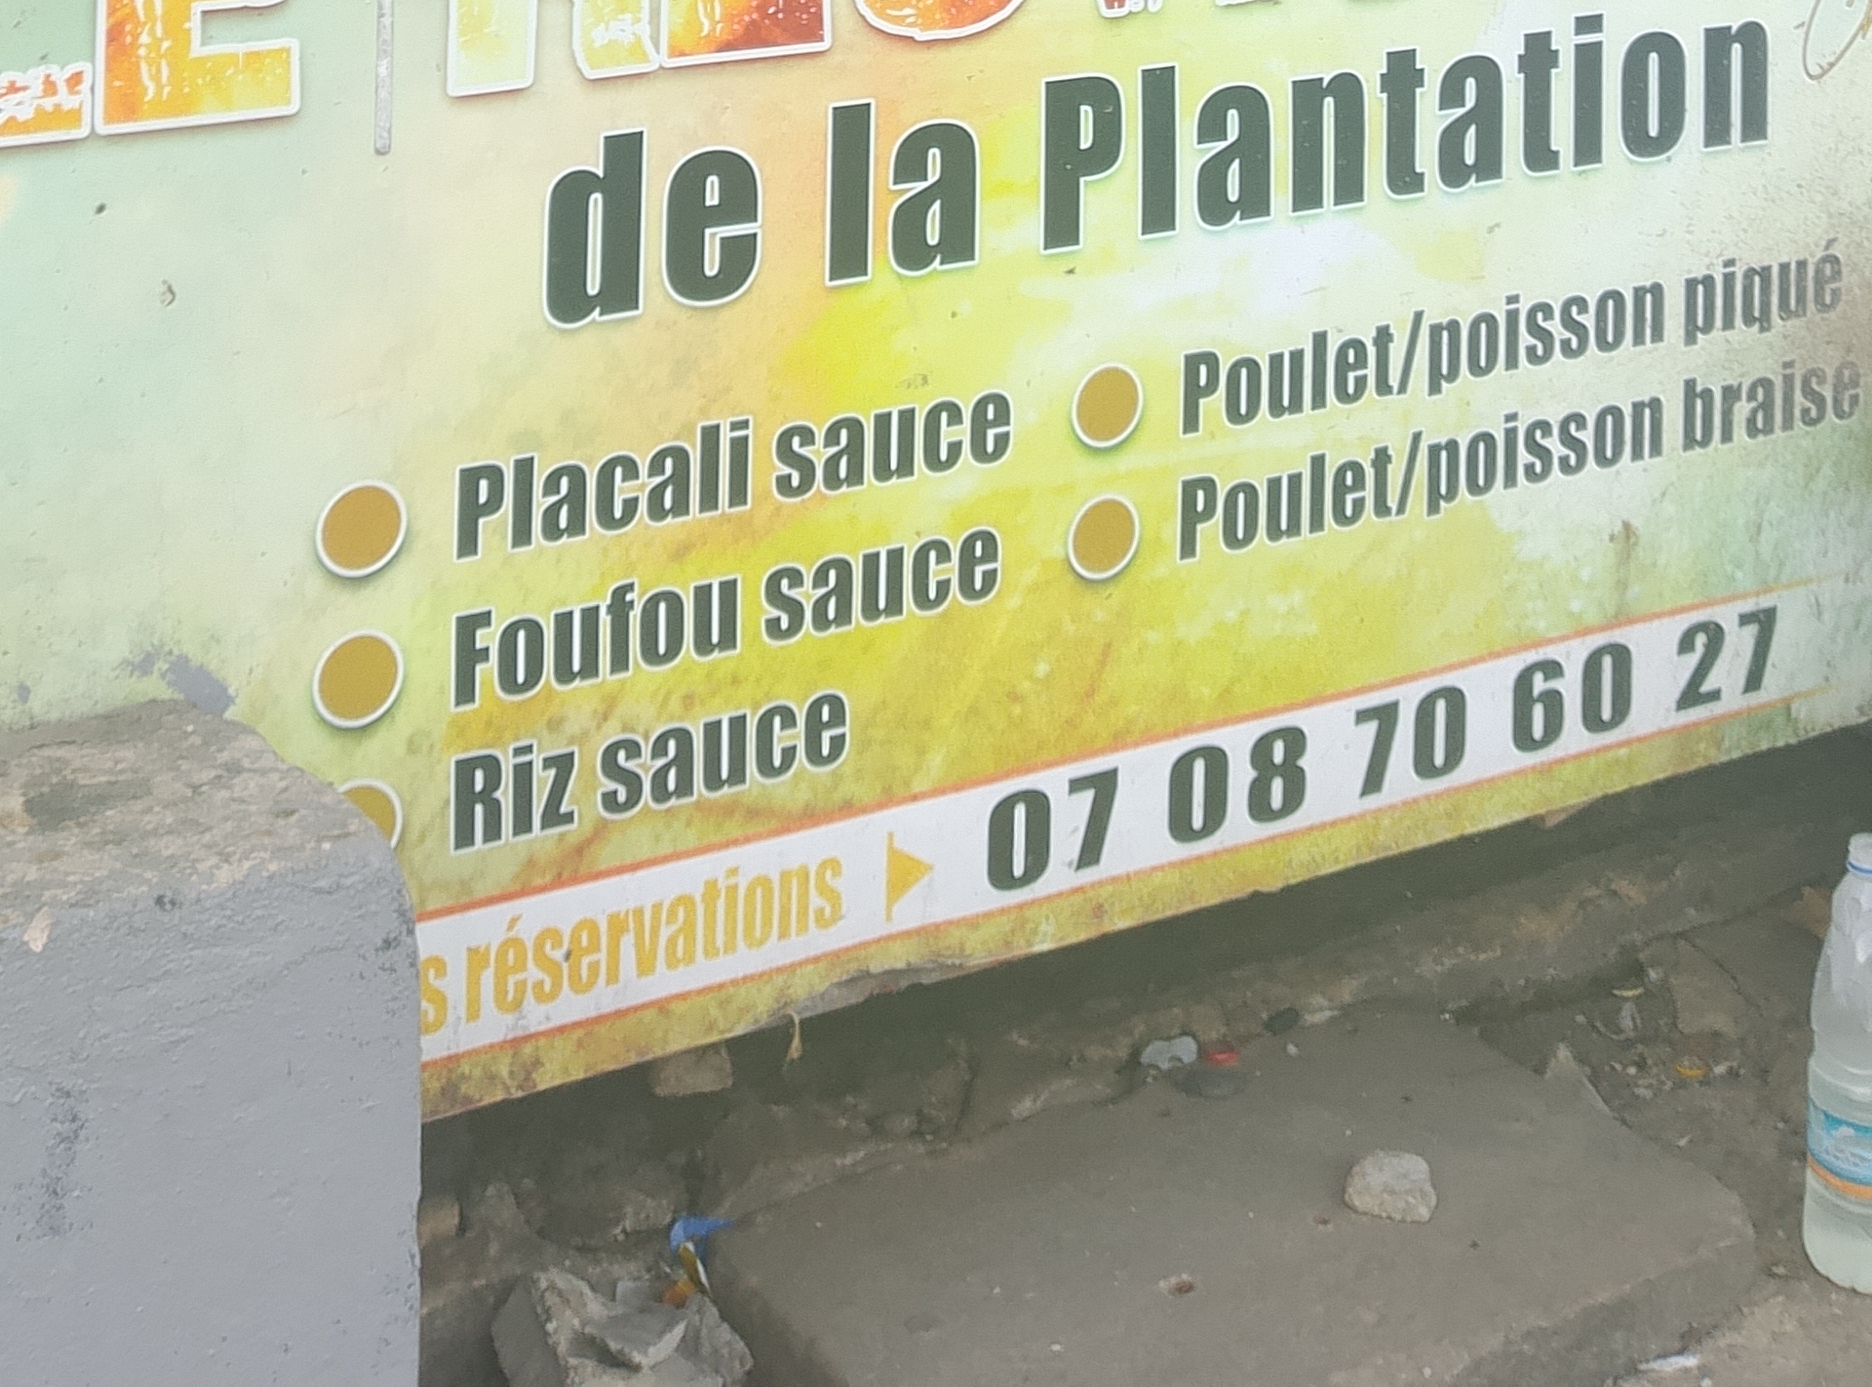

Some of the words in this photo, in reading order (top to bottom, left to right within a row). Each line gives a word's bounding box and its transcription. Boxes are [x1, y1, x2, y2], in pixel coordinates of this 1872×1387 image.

[543, 128, 762, 330] de
[824, 98, 979, 287] la
[1040, 12, 1769, 254] Plantation
[1179, 279, 1666, 438] Poulet/poisson
[1683, 236, 1843, 347] piqué
[454, 416, 752, 562] Placali
[772, 389, 1014, 501] sauce
[1176, 393, 1665, 562] Poulet/poisson
[452, 580, 741, 712] Foufou
[762, 527, 1000, 642] sauce
[452, 741, 577, 854] Riz
[598, 691, 848, 823] sauce
[986, 766, 1120, 891] 07
[1167, 725, 1308, 846] 08
[1355, 685, 1468, 801] 70
[1511, 641, 1634, 754] 60
[1675, 605, 1779, 715] 27
[465, 854, 843, 1024] réservations
